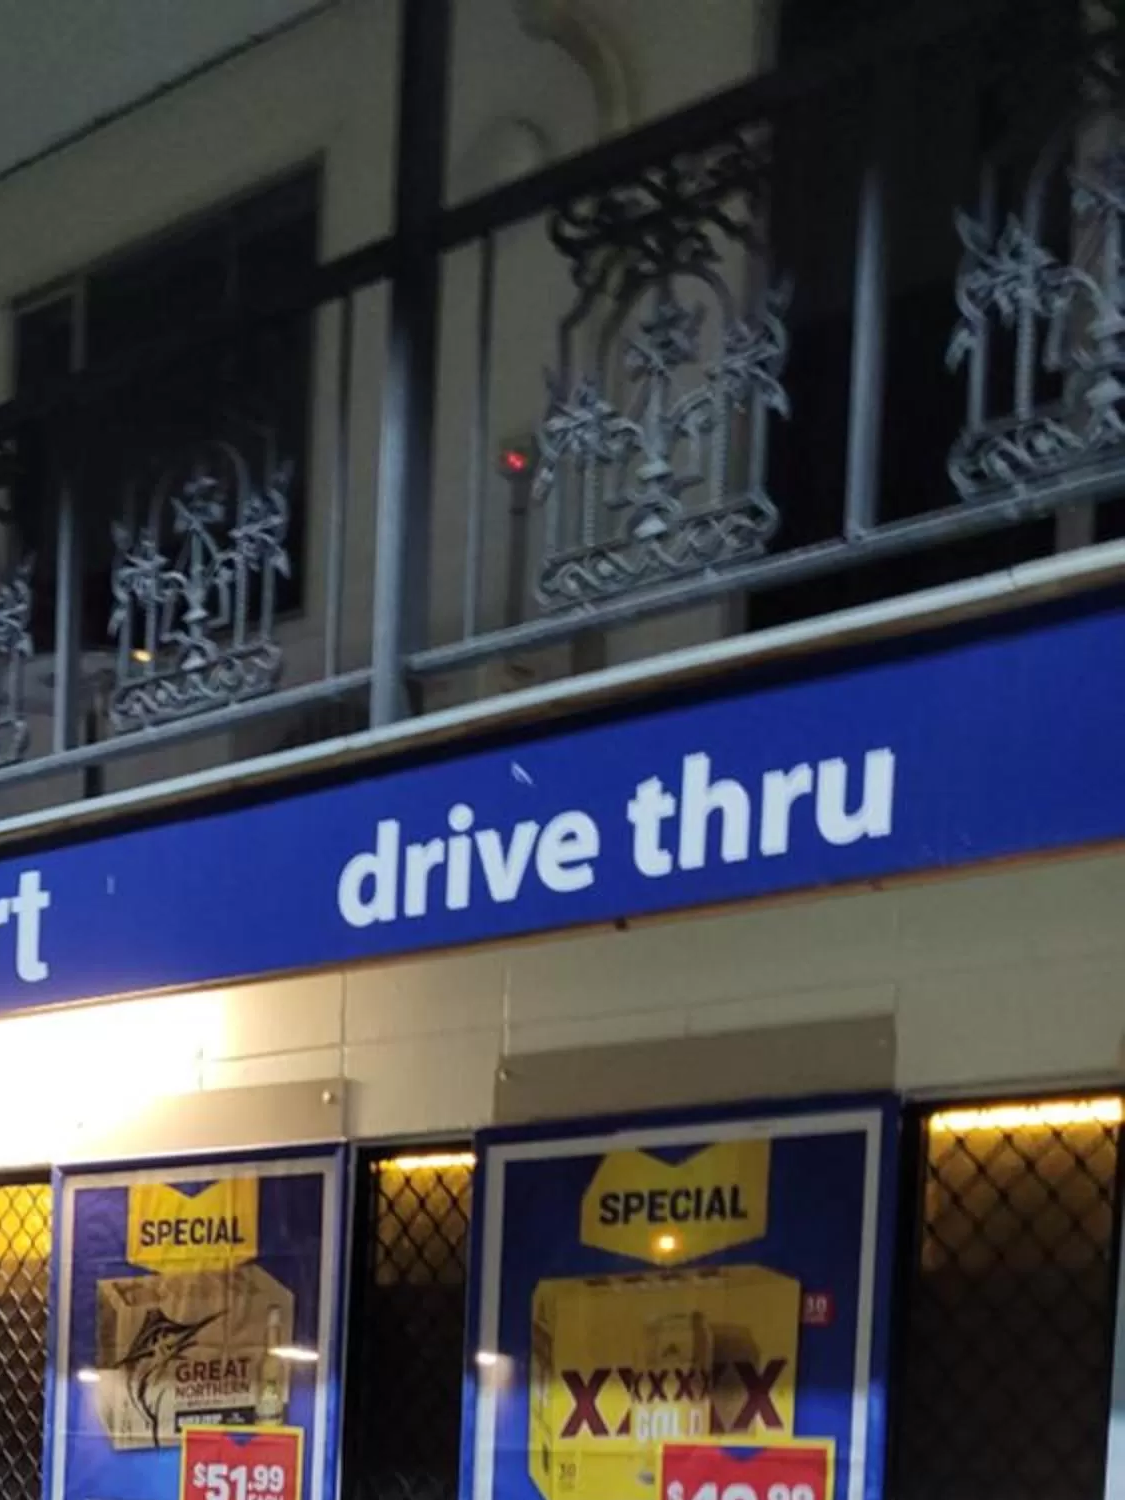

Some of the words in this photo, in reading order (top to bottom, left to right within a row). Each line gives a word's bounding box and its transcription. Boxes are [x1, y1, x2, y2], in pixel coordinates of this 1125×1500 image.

[336, 803, 601, 928] drive
[626, 747, 895, 878] thru
[598, 1185, 748, 1226] SPECIAL
[140, 1216, 246, 1247] SPECIAL
[175, 1356, 252, 1383] GREAT
